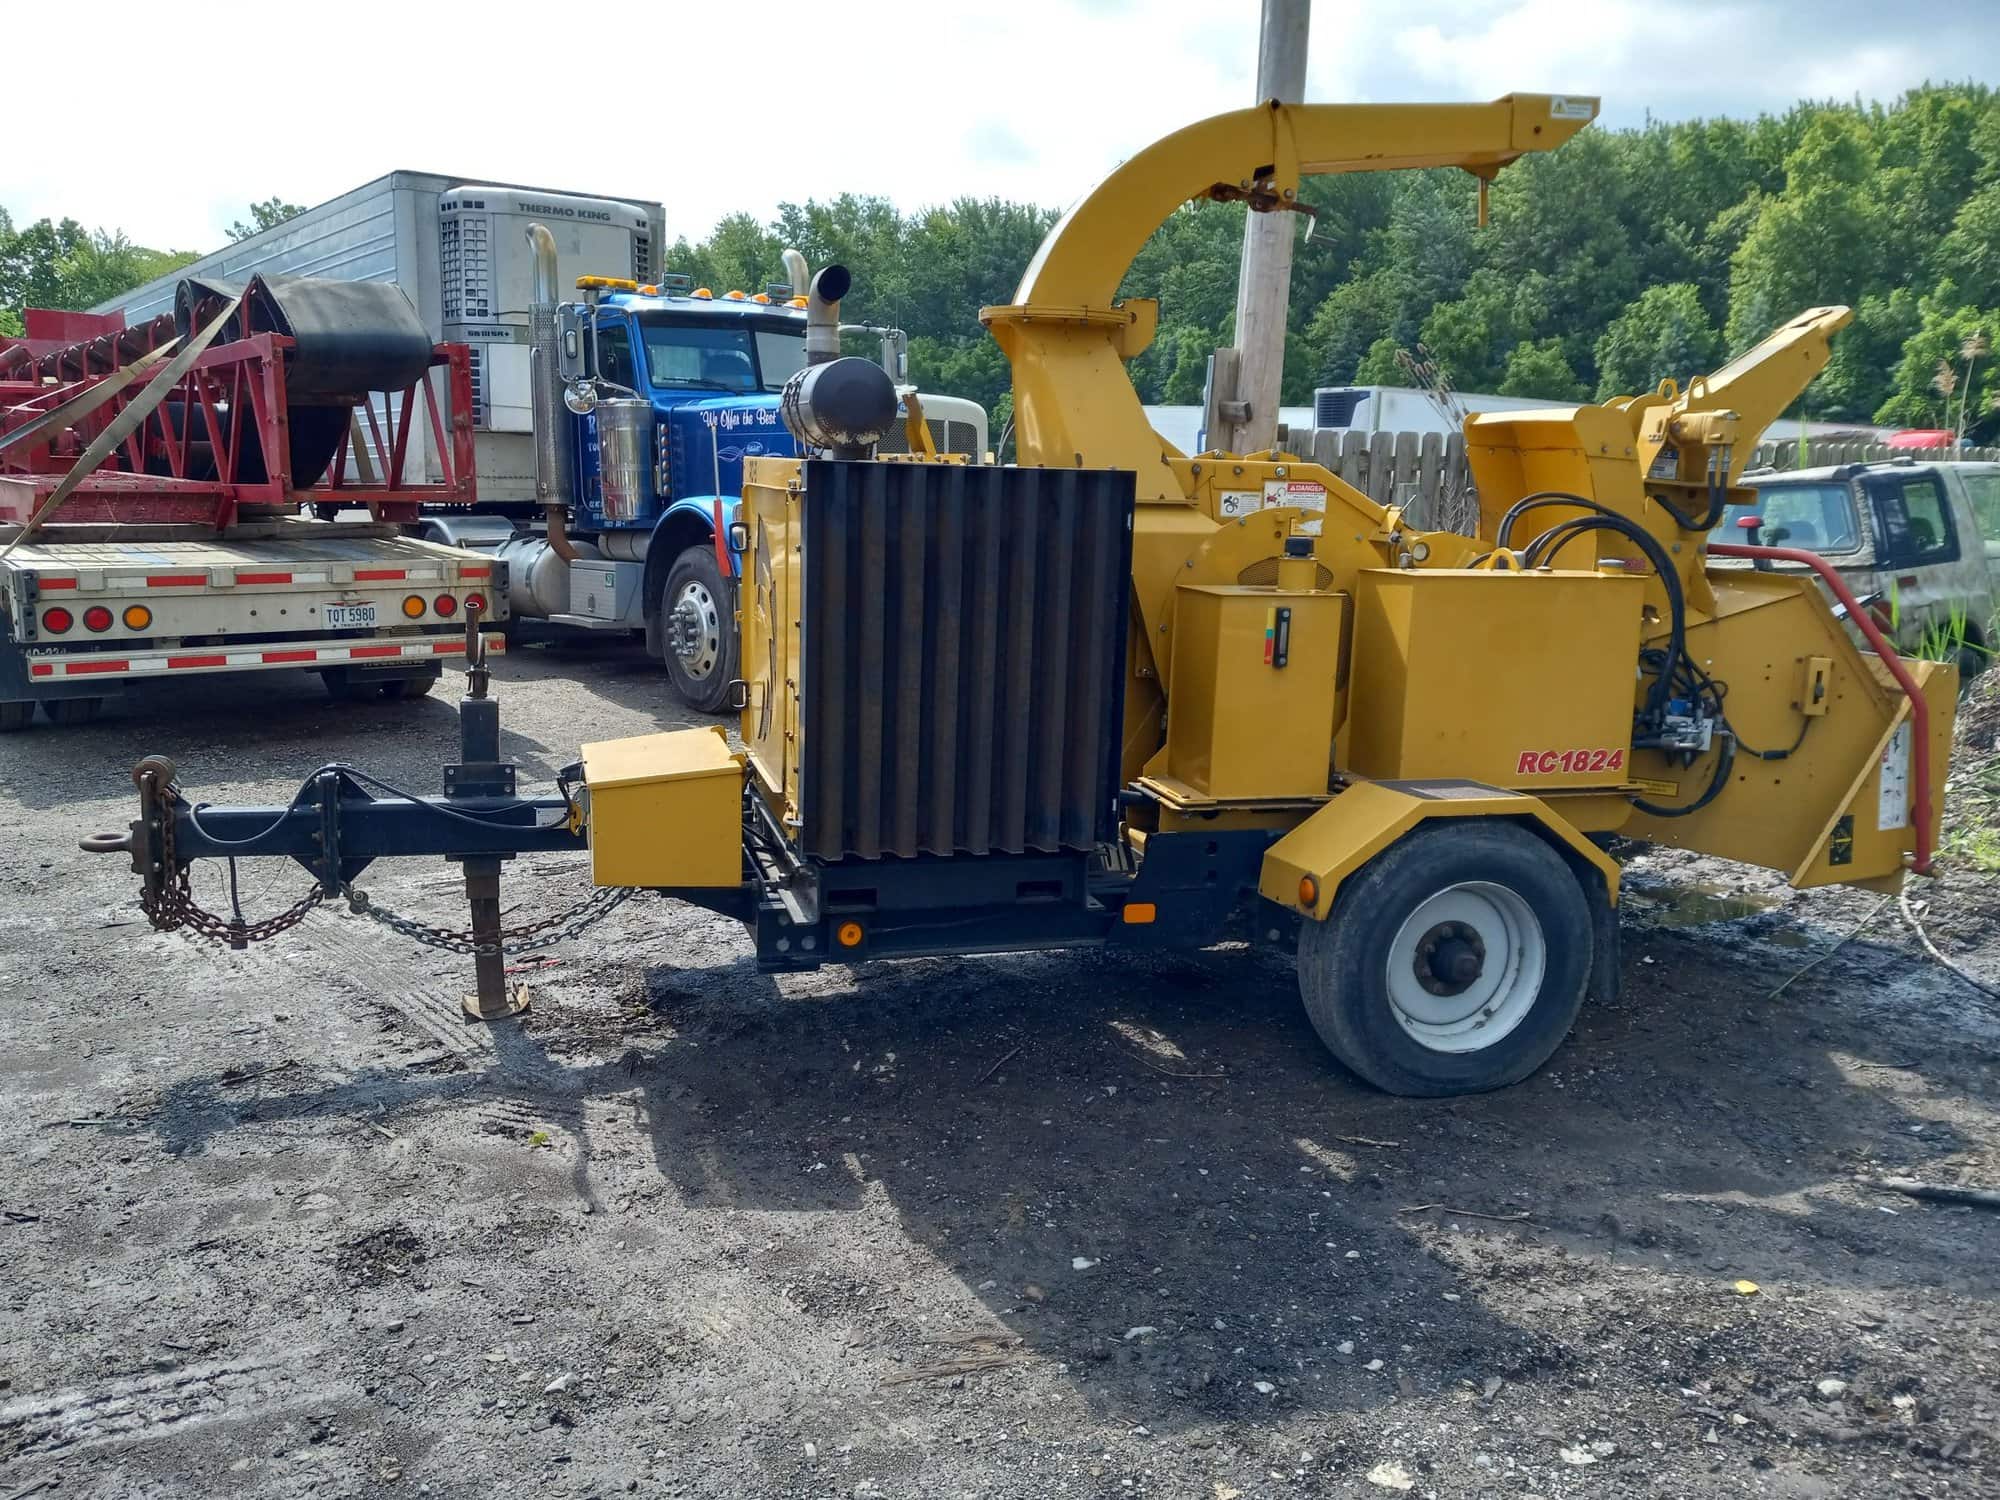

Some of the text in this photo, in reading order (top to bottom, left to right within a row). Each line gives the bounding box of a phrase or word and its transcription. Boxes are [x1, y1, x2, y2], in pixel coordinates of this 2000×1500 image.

[518, 202, 611, 221] THERMO KING
[742, 408, 754, 425] the
[348, 607, 375, 622] 5980
[1516, 748, 1625, 774] RC1824
